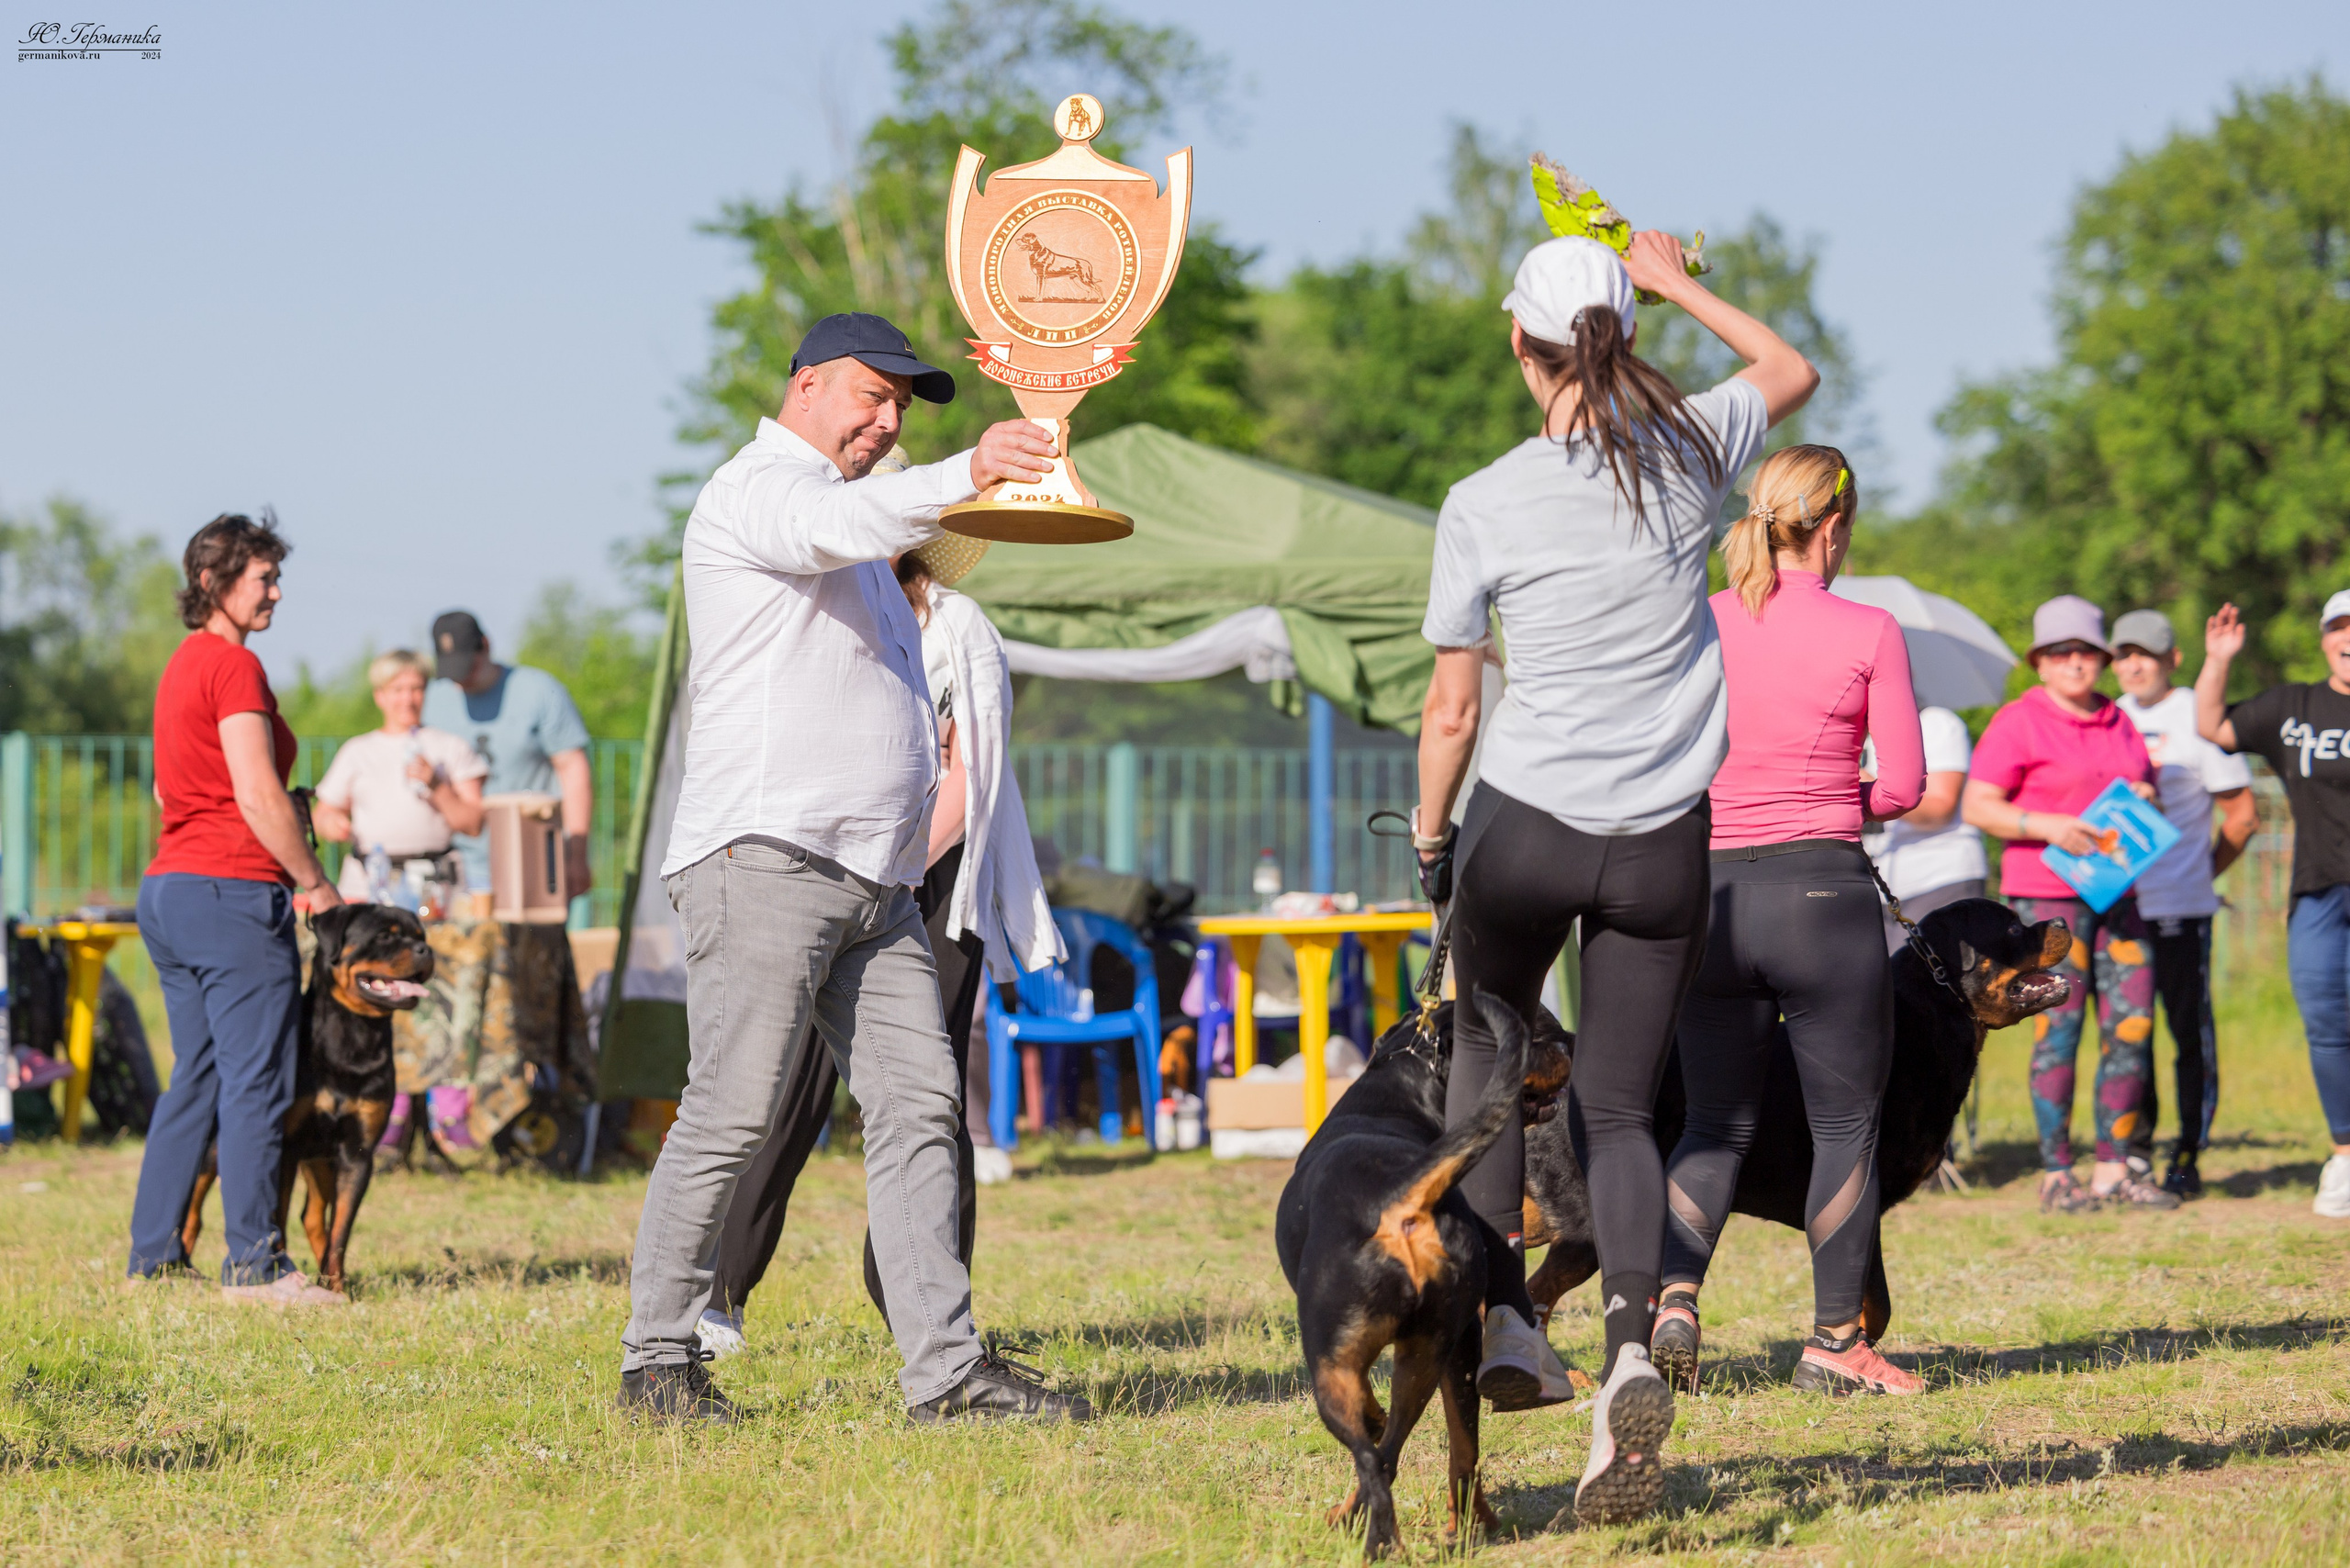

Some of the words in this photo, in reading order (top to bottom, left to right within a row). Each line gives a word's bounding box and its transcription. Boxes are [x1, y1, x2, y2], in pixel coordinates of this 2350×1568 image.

[989, 206, 1033, 315] МОНОПОРОДНАЯ
[1037, 196, 1113, 222] ВЫСТАВКА
[1102, 218, 1135, 319] РОТВЕЙЛЕРОВ
[984, 360, 1062, 386] ВОРОНЕЖСКИЕ
[1066, 363, 1116, 386] ВСТРЕЧИ
[1805, 1354, 1852, 1376] SALOMON
